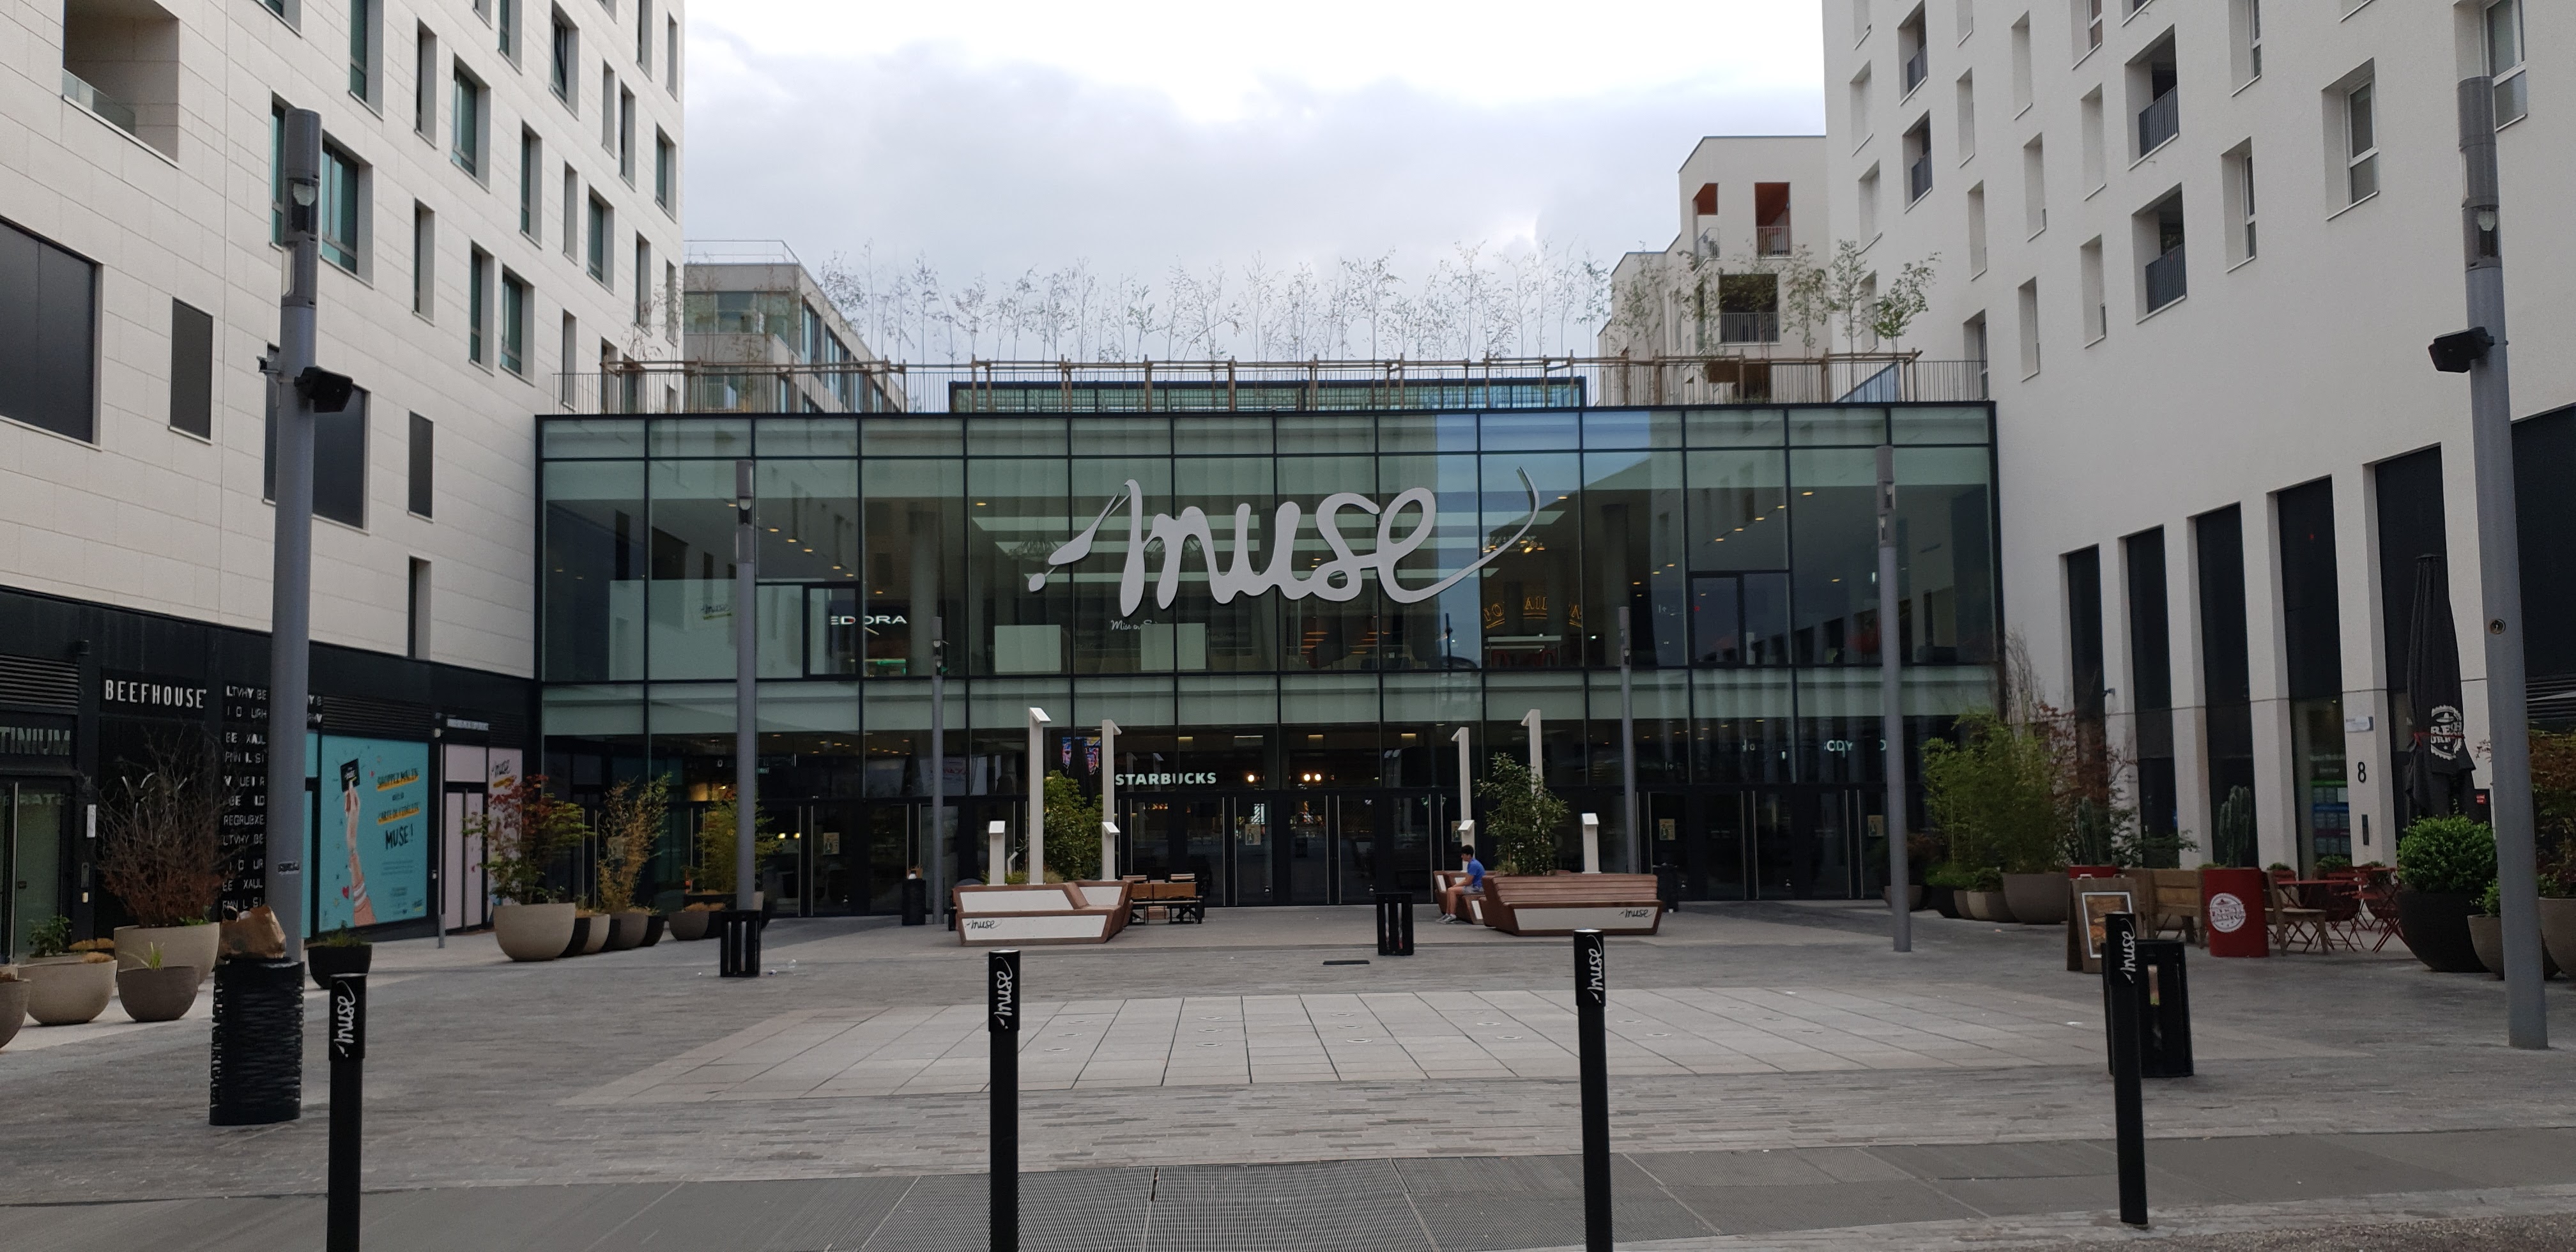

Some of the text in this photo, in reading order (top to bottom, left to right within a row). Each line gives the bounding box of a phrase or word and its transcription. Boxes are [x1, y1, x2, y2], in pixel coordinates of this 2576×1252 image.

[1029, 466, 1540, 617] muse
[1110, 620, 1131, 630] Mise
[105, 680, 207, 709] BEEFHOUSE
[0, 726, 70, 756] TINIUM
[1115, 772, 1217, 786] STARBUCKS
[2358, 761, 2366, 783] 8
[966, 919, 1002, 929] muse
[1619, 908, 1656, 918] muse
[2120, 917, 2136, 984] muse
[1586, 935, 1604, 1004] muse
[993, 956, 1013, 1029] muse
[334, 981, 356, 1058] muse
